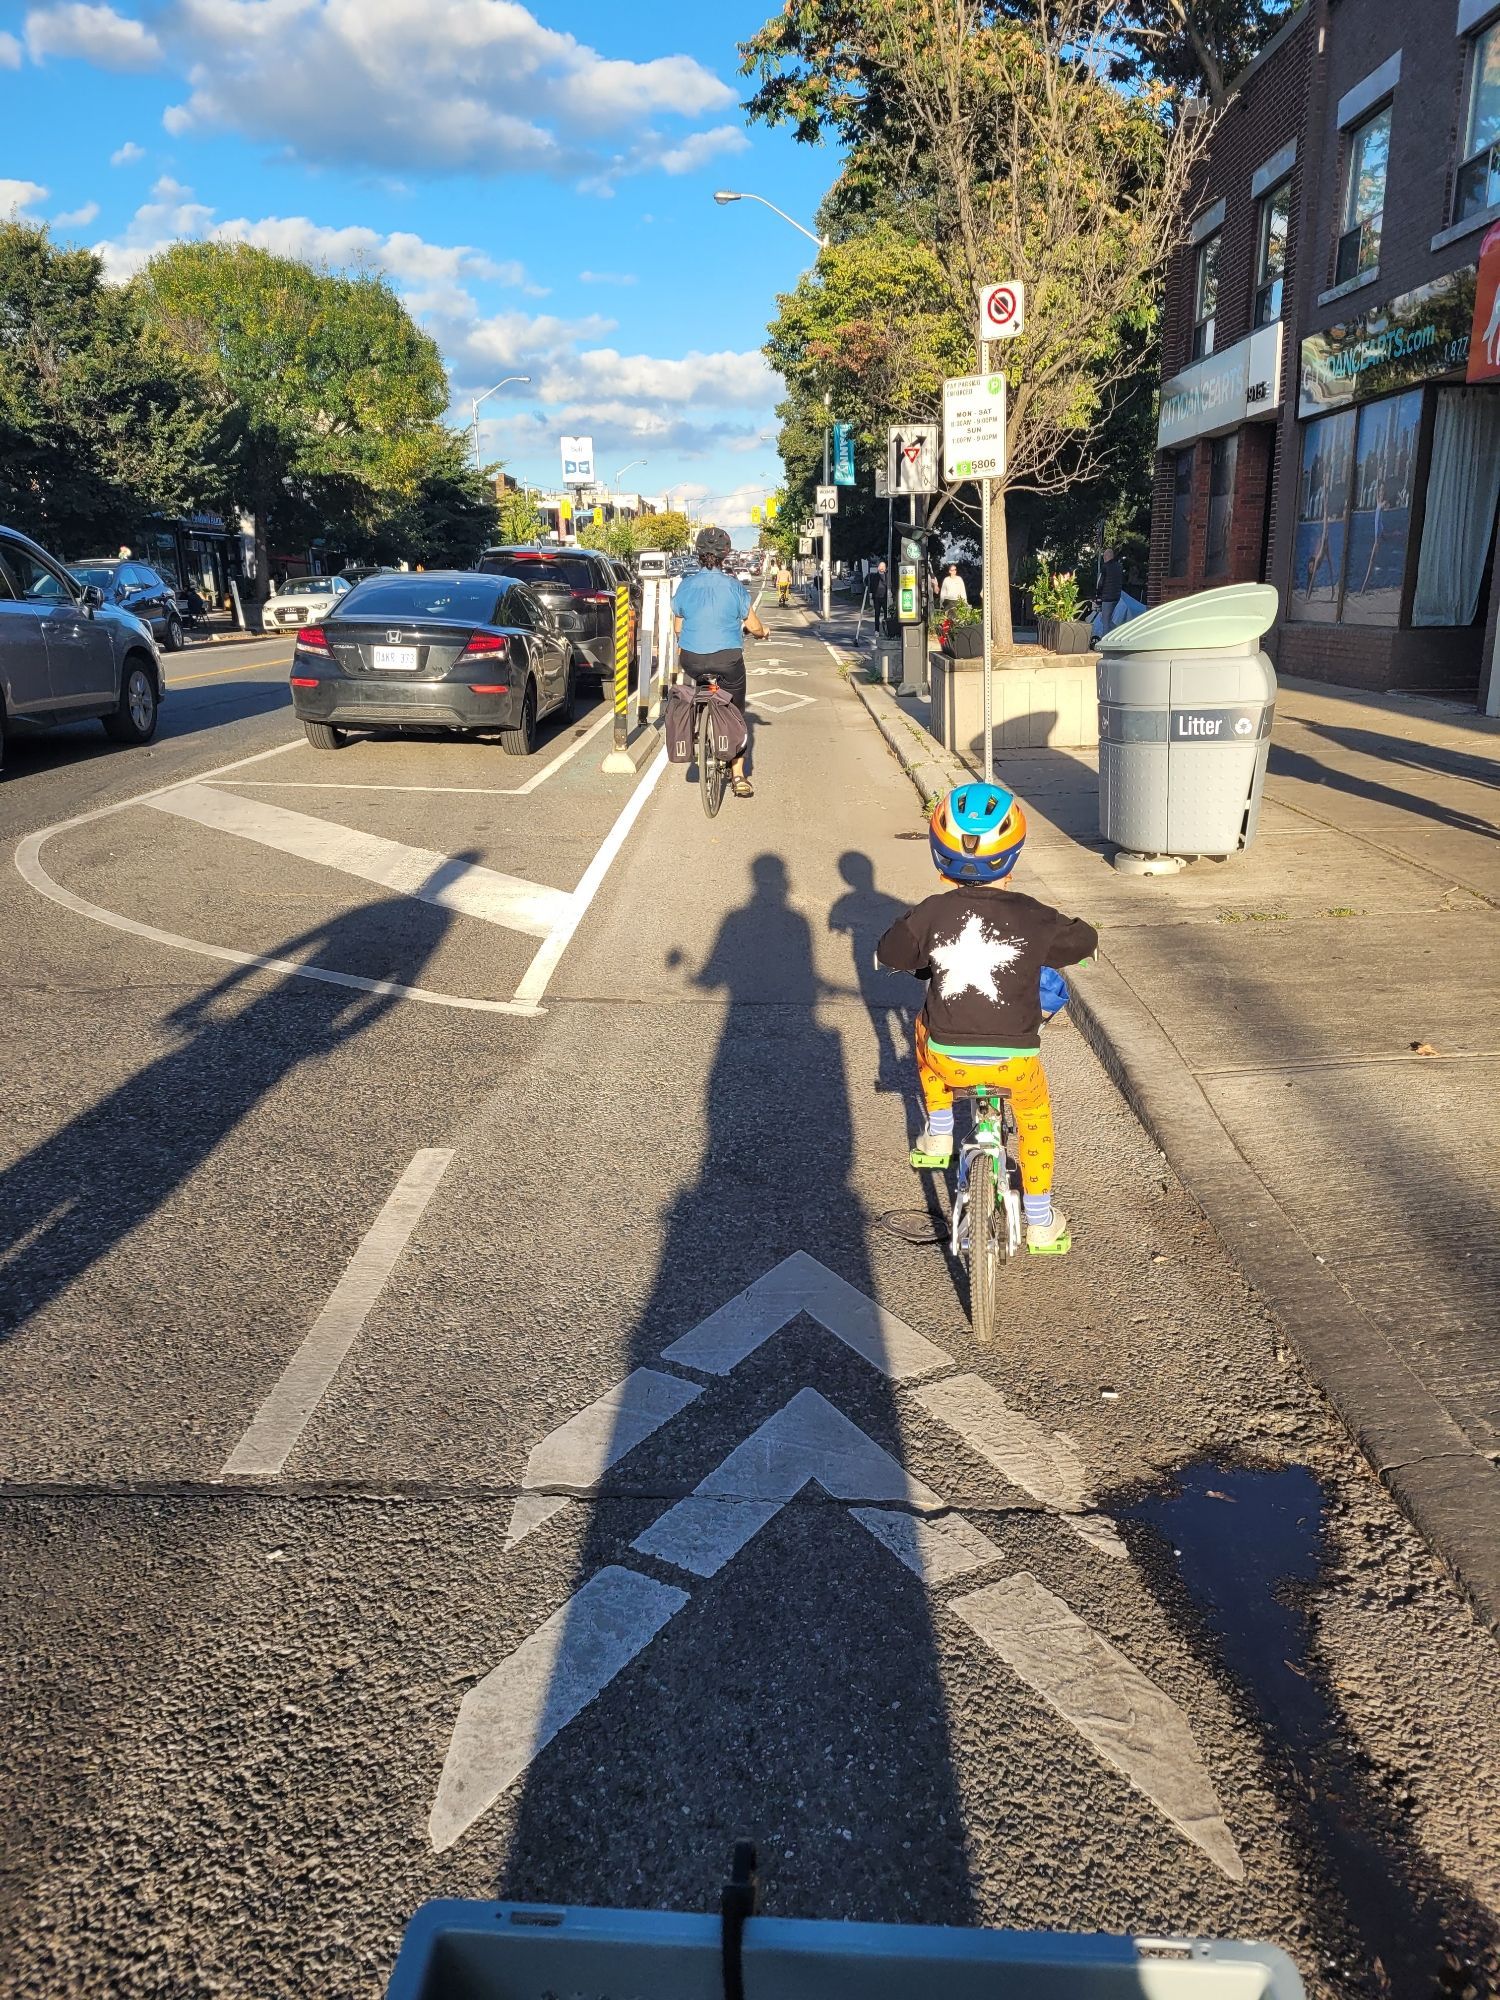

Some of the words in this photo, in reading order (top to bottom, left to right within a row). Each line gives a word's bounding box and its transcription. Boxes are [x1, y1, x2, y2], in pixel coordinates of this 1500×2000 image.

[971, 458, 996, 470] 5806
[819, 498, 836, 510] 40
[1179, 715, 1222, 736] Litter
